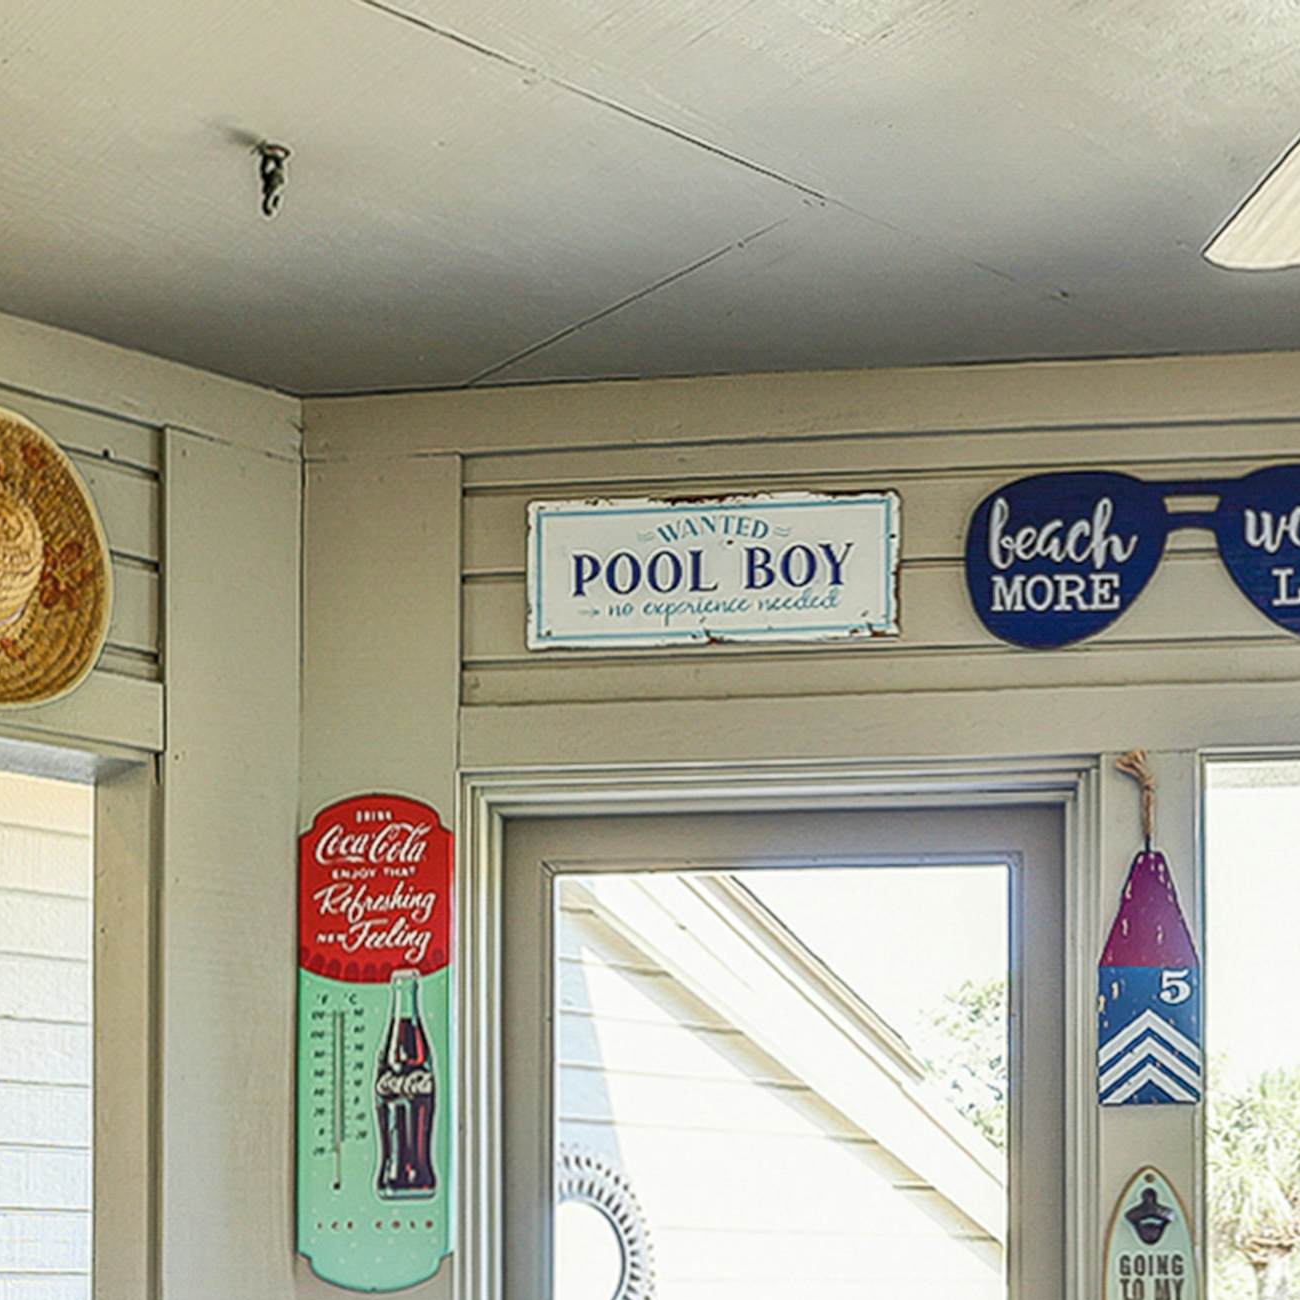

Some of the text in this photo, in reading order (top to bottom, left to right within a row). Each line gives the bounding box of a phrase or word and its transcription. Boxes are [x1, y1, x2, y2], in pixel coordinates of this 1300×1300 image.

[657, 515, 769, 543] WANTED
[989, 497, 1138, 569] beach
[572, 542, 854, 597] POOL BOY
[608, 588, 839, 626] no experience needed
[991, 573, 1121, 611] MORE
[331, 868, 377, 880] ENJOY
[313, 880, 436, 923] Refreshing
[342, 916, 432, 963] Feeling
[1160, 969, 1192, 1004] 5
[1119, 1254, 1184, 1276] GOING
[1120, 1278, 1144, 1300] TO
